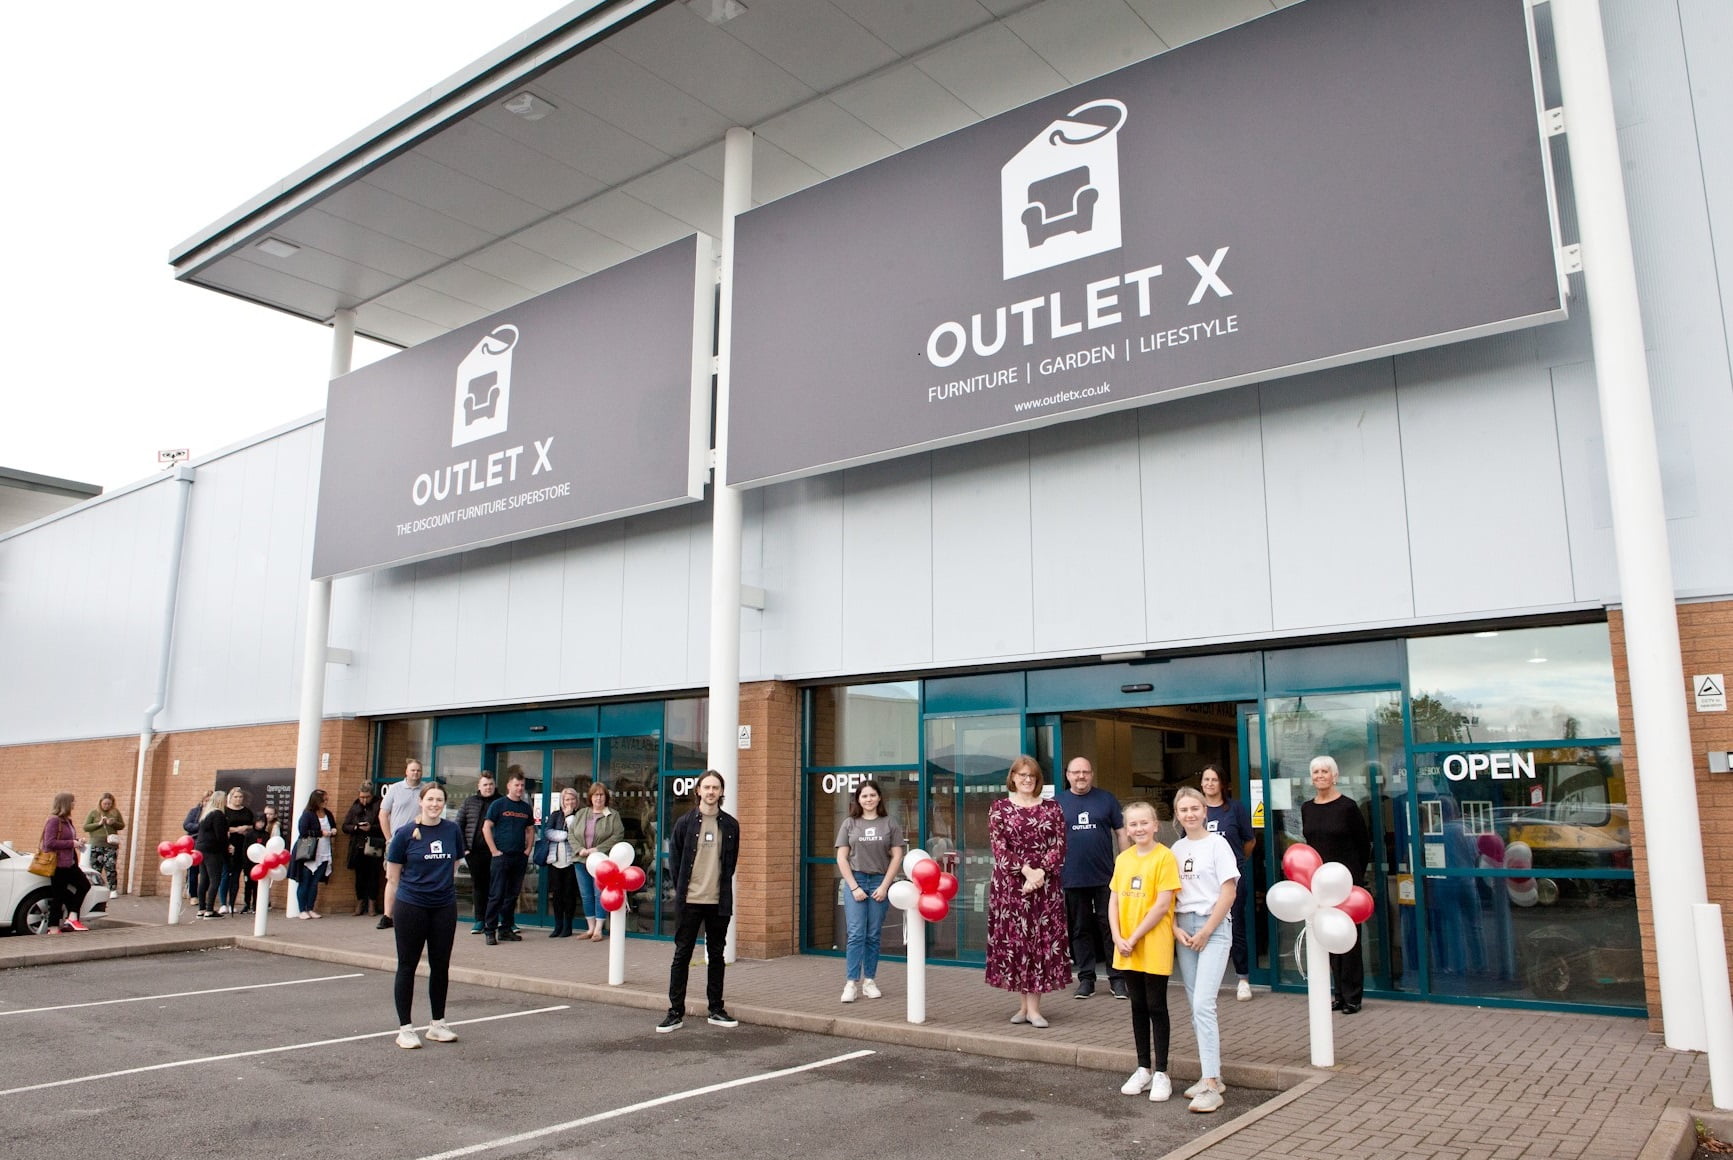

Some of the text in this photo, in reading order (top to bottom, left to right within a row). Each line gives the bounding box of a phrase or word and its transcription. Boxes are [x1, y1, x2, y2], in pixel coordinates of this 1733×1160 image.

[926, 246, 1233, 368] OUTLET X
[928, 314, 1239, 403] FURNITURE GARDEN LIFESTYLE
[1014, 381, 1111, 412] www.outletx.co.uk
[412, 436, 554, 507] OUTLET X
[396, 482, 571, 537] THE DISCOUNT FURNITURE SUPERSTORE
[1443, 752, 1537, 781] OPEN
